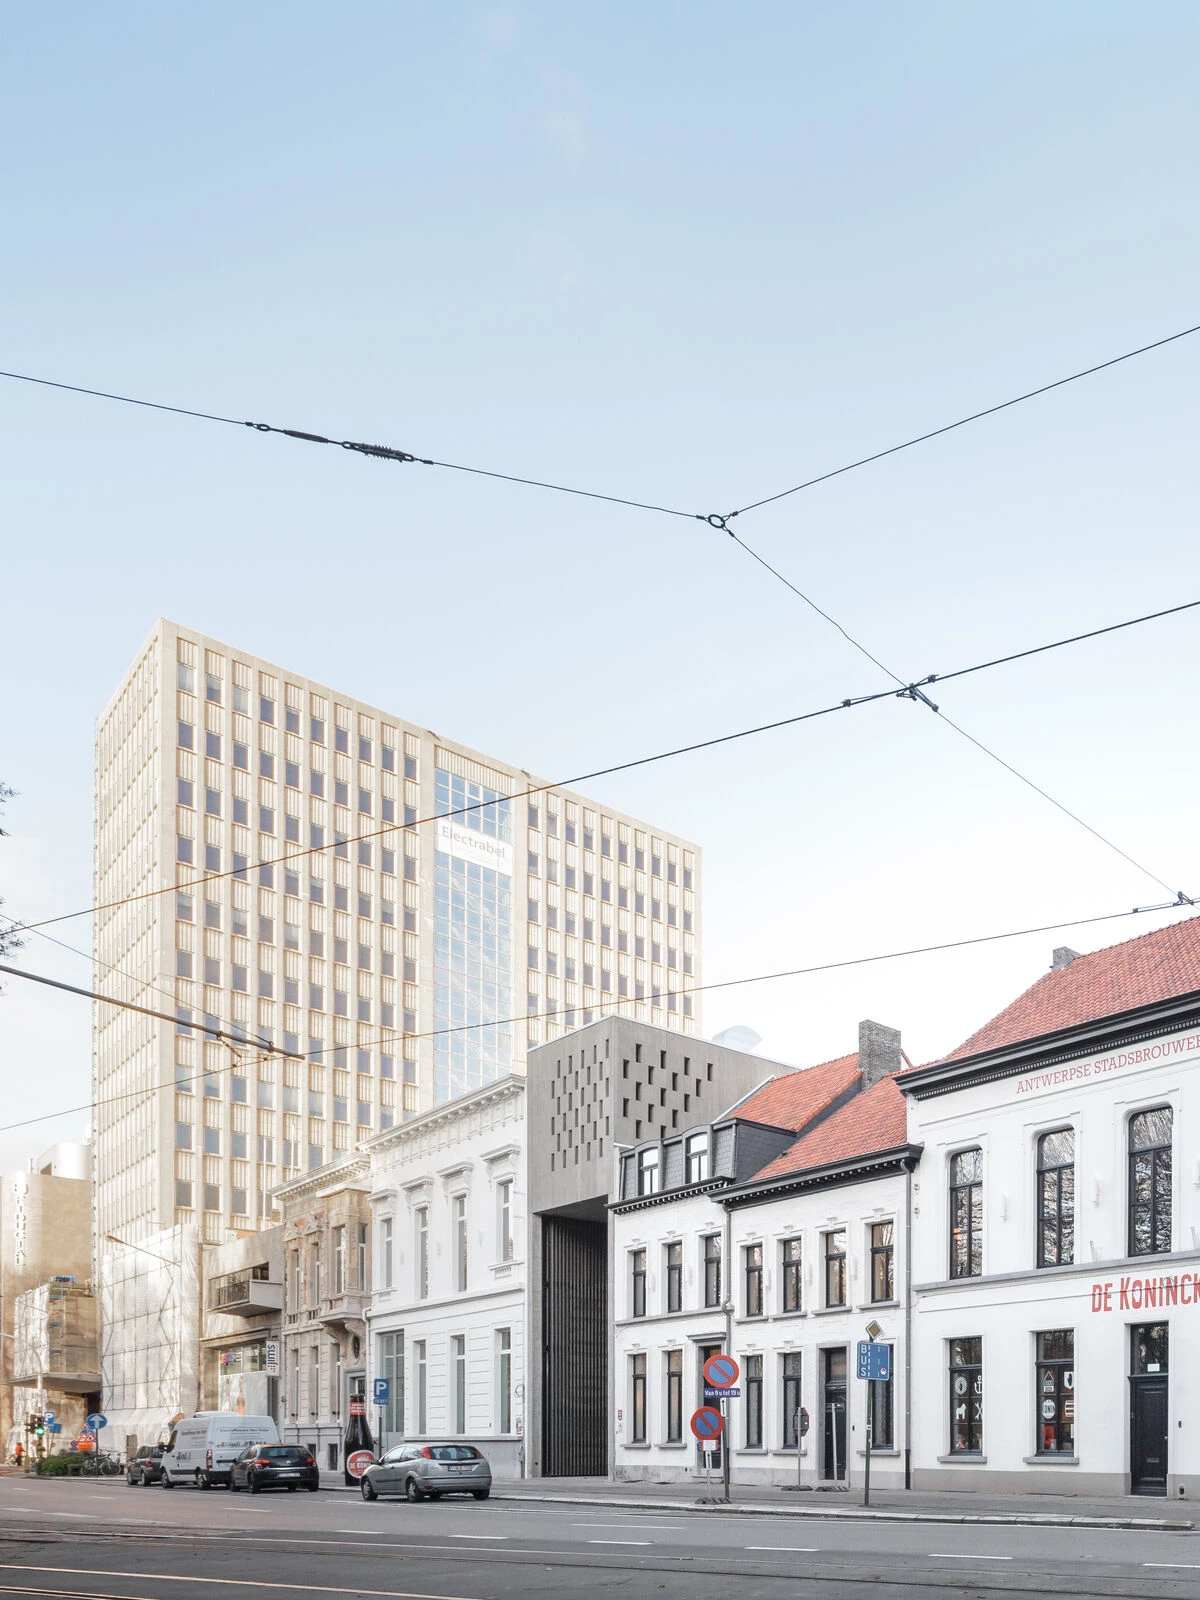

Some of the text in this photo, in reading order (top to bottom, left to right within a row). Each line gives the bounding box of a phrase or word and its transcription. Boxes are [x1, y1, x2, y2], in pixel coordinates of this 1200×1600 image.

[443, 826, 505, 858] Electrabel
[1016, 1063, 1091, 1094] ANTWERPSE
[1092, 1283, 1113, 1312] DE
[376, 1382, 387, 1396] P
